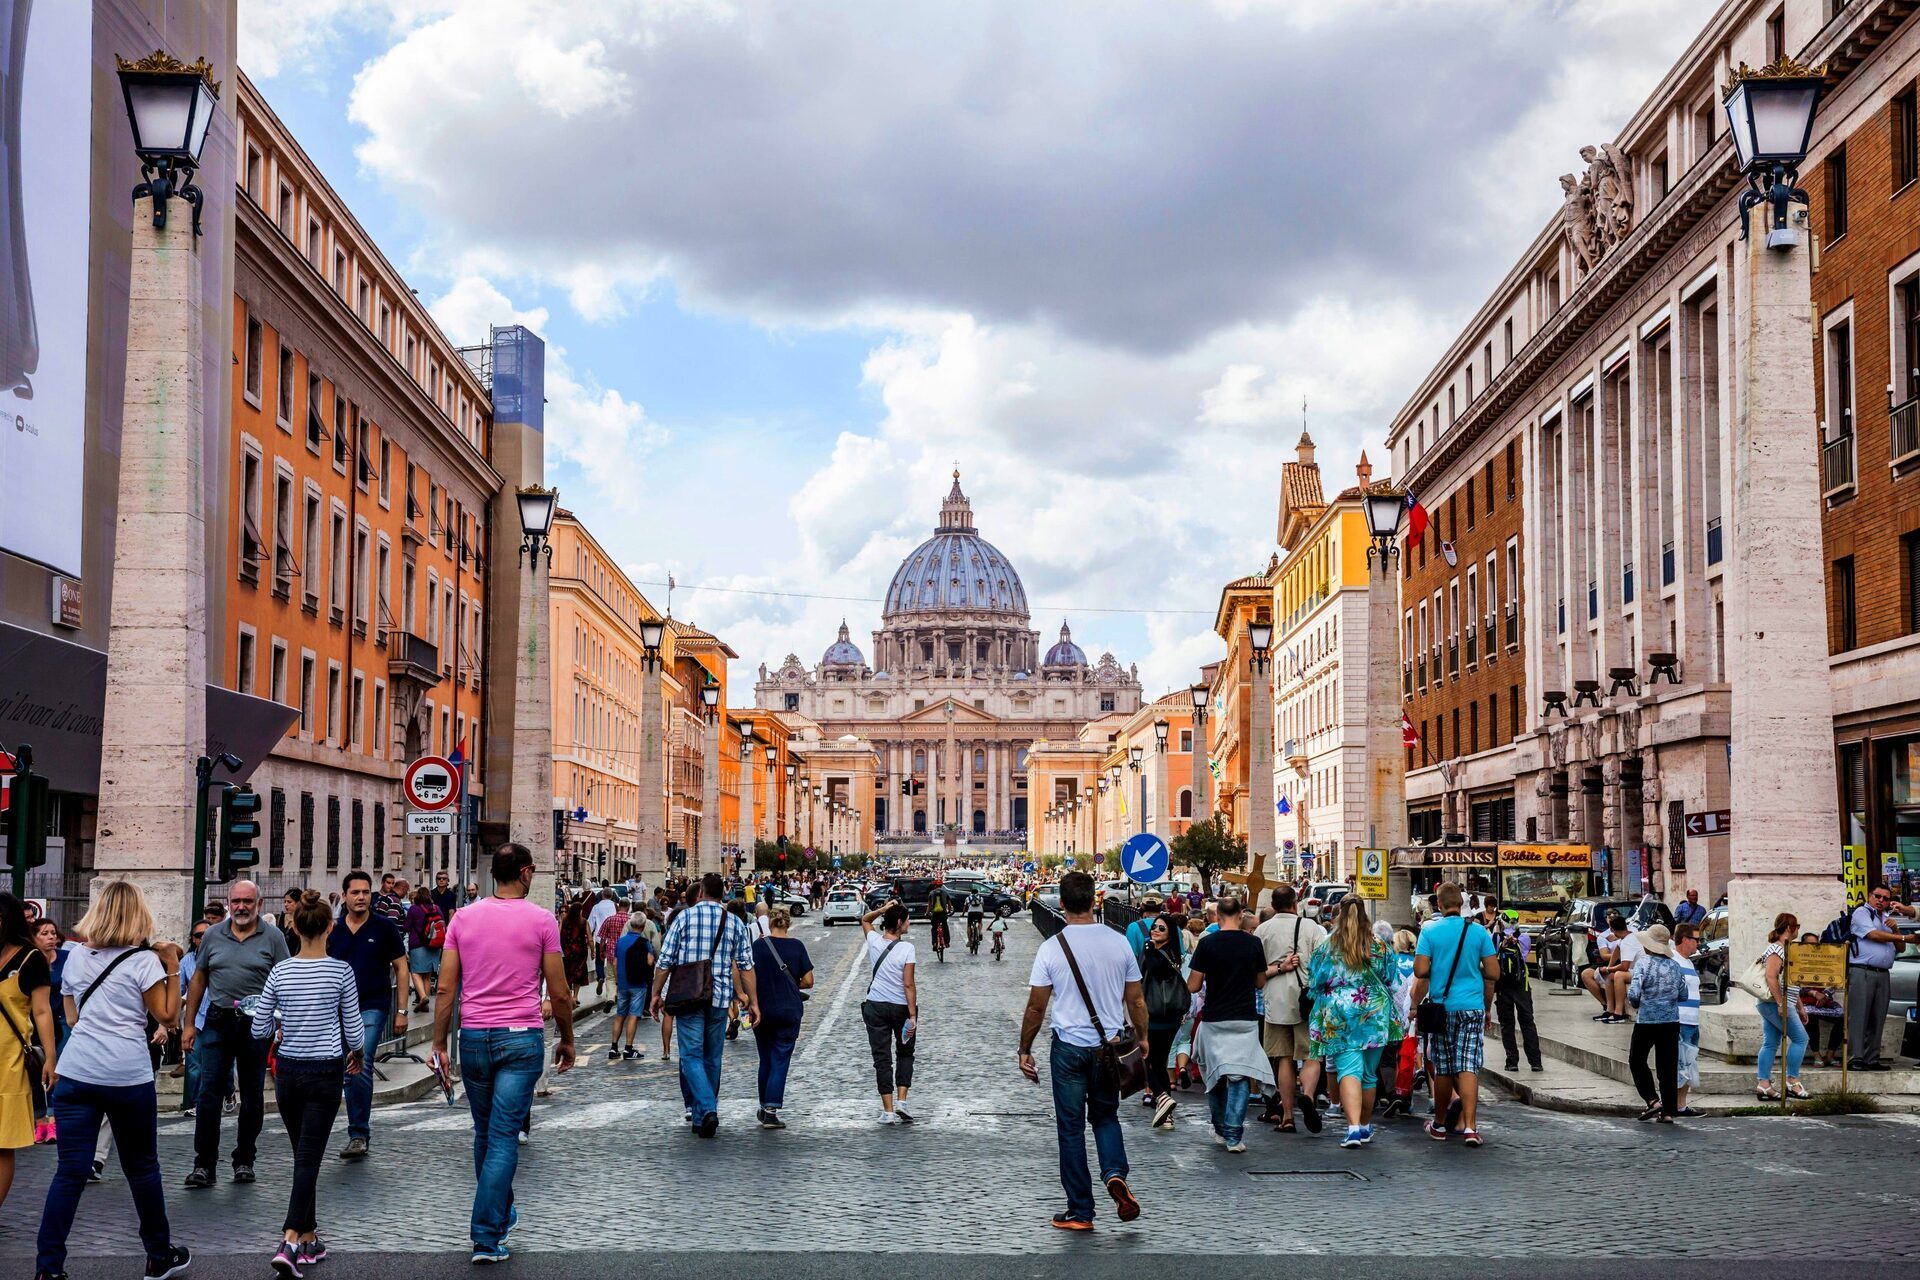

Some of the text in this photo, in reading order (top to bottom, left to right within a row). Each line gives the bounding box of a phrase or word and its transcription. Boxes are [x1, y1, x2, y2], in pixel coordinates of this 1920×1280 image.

[7, 693, 62, 728] lavori
[51, 703, 79, 730] di
[66, 713, 104, 737] conse
[1432, 851, 1494, 863] DRINKS
[1502, 850, 1542, 861] Bibite
[1546, 851, 1589, 864] Gelati
